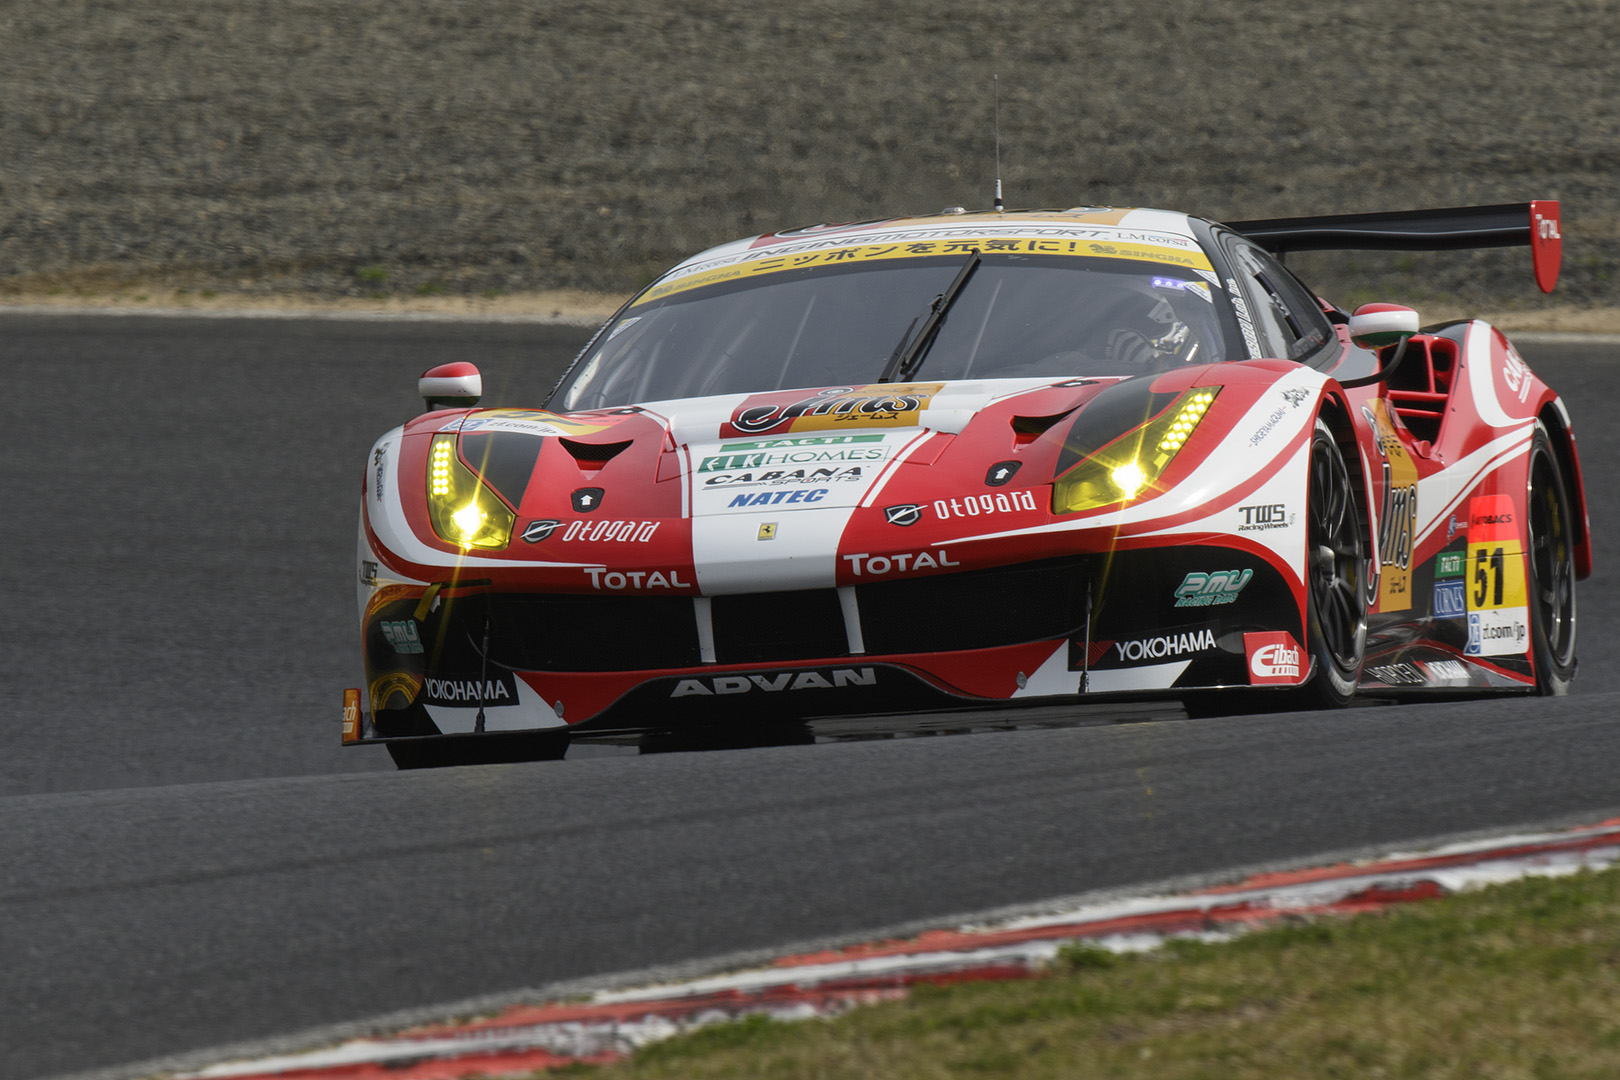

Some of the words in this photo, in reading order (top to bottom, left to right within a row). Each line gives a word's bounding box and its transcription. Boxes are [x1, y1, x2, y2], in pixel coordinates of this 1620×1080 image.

[1119, 249, 1196, 266] SINGHA
[754, 436, 855, 449] TACTI
[705, 467, 863, 486] CABANA
[769, 476, 863, 487] SPORTS
[727, 488, 829, 508] NATEC
[843, 550, 960, 576] TOTAL
[583, 567, 691, 589] TOTAL
[1474, 547, 1504, 608] 51
[1115, 629, 1217, 661] YOKOHAMA
[424, 677, 510, 701] YOKOHAMA
[669, 667, 878, 698] ADVAN
